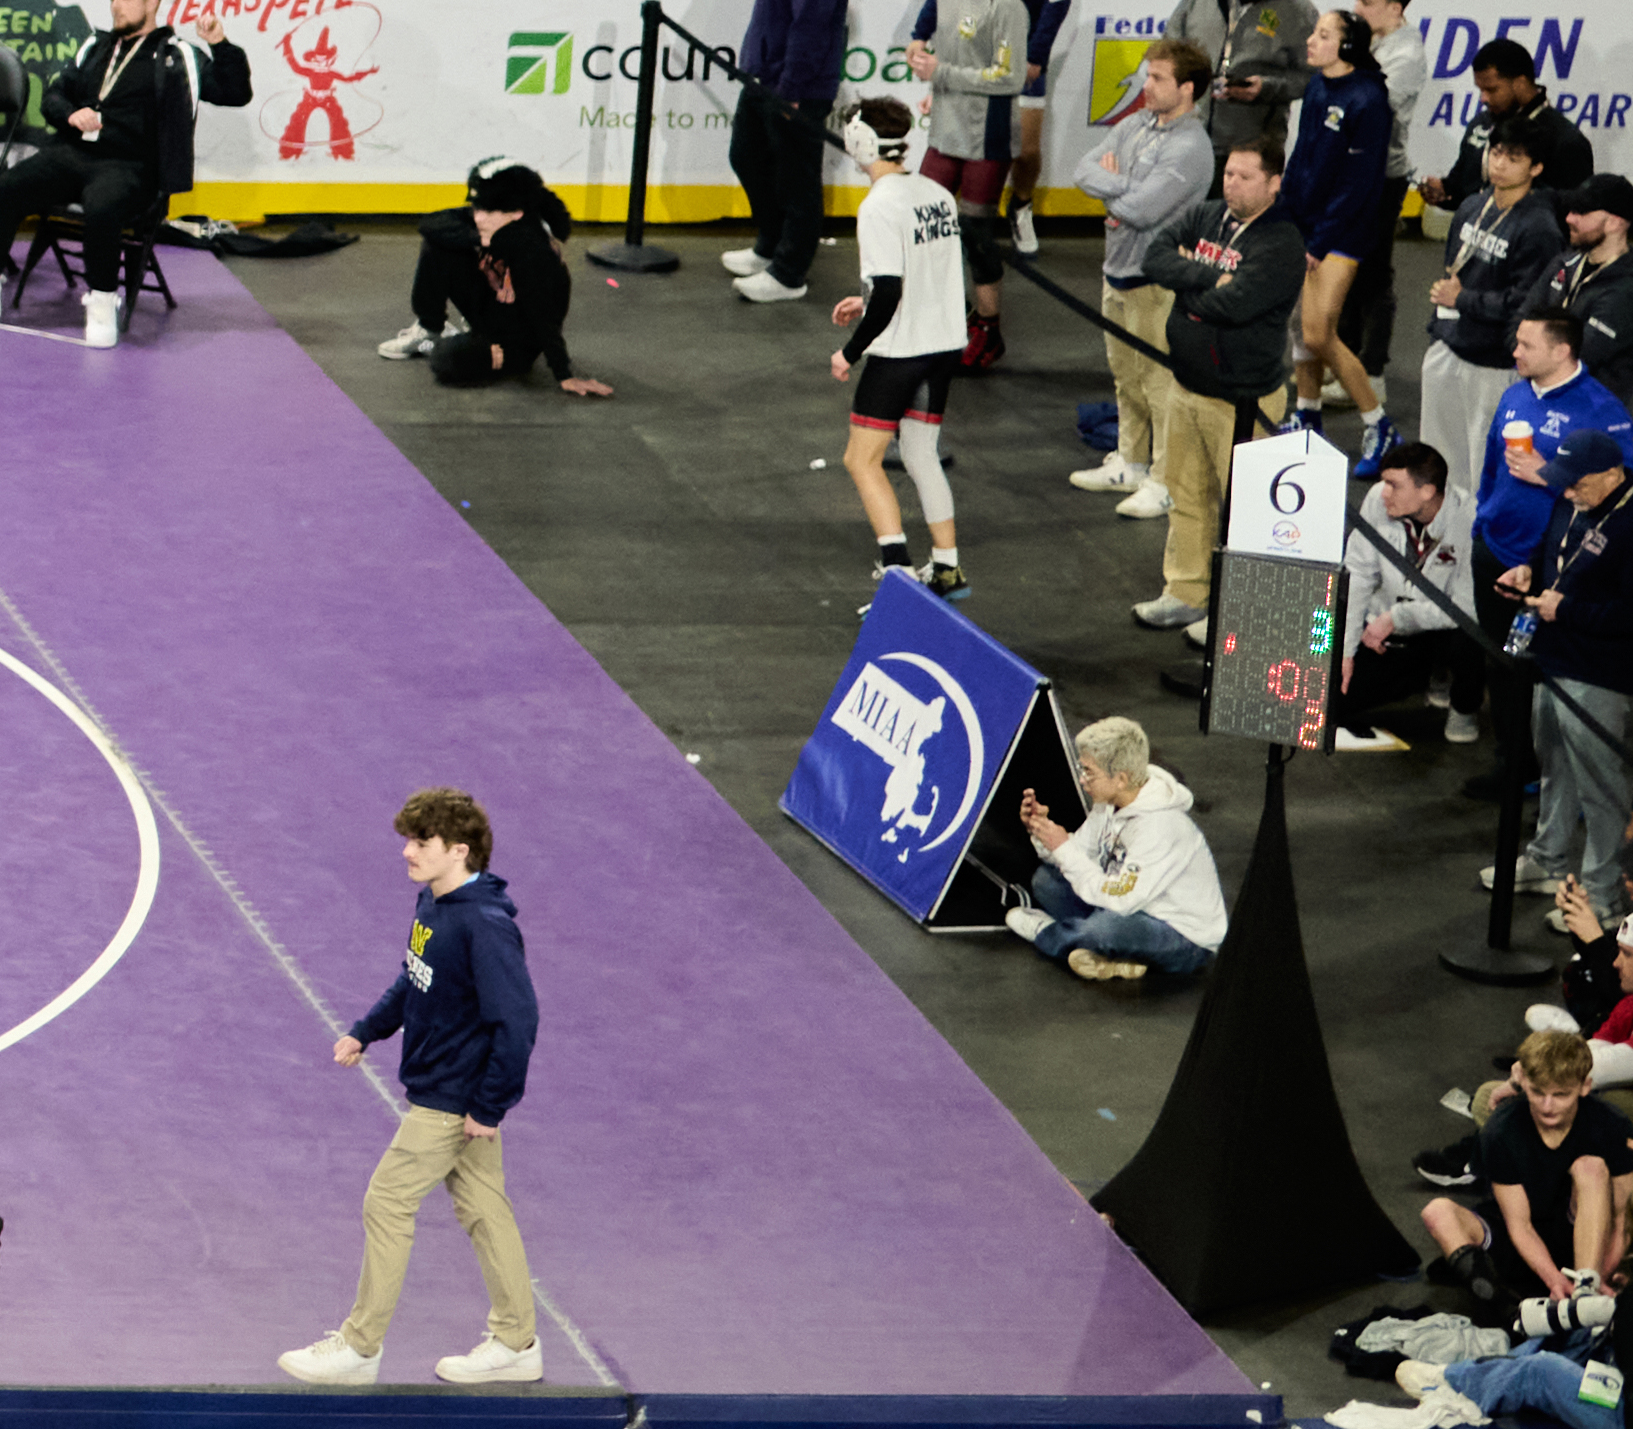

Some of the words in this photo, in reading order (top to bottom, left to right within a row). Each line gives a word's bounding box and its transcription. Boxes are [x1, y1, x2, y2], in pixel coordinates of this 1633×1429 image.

[667, 109, 695, 129] to
[1269, 463, 1306, 516] 6
[847, 679, 918, 757] MIAA
